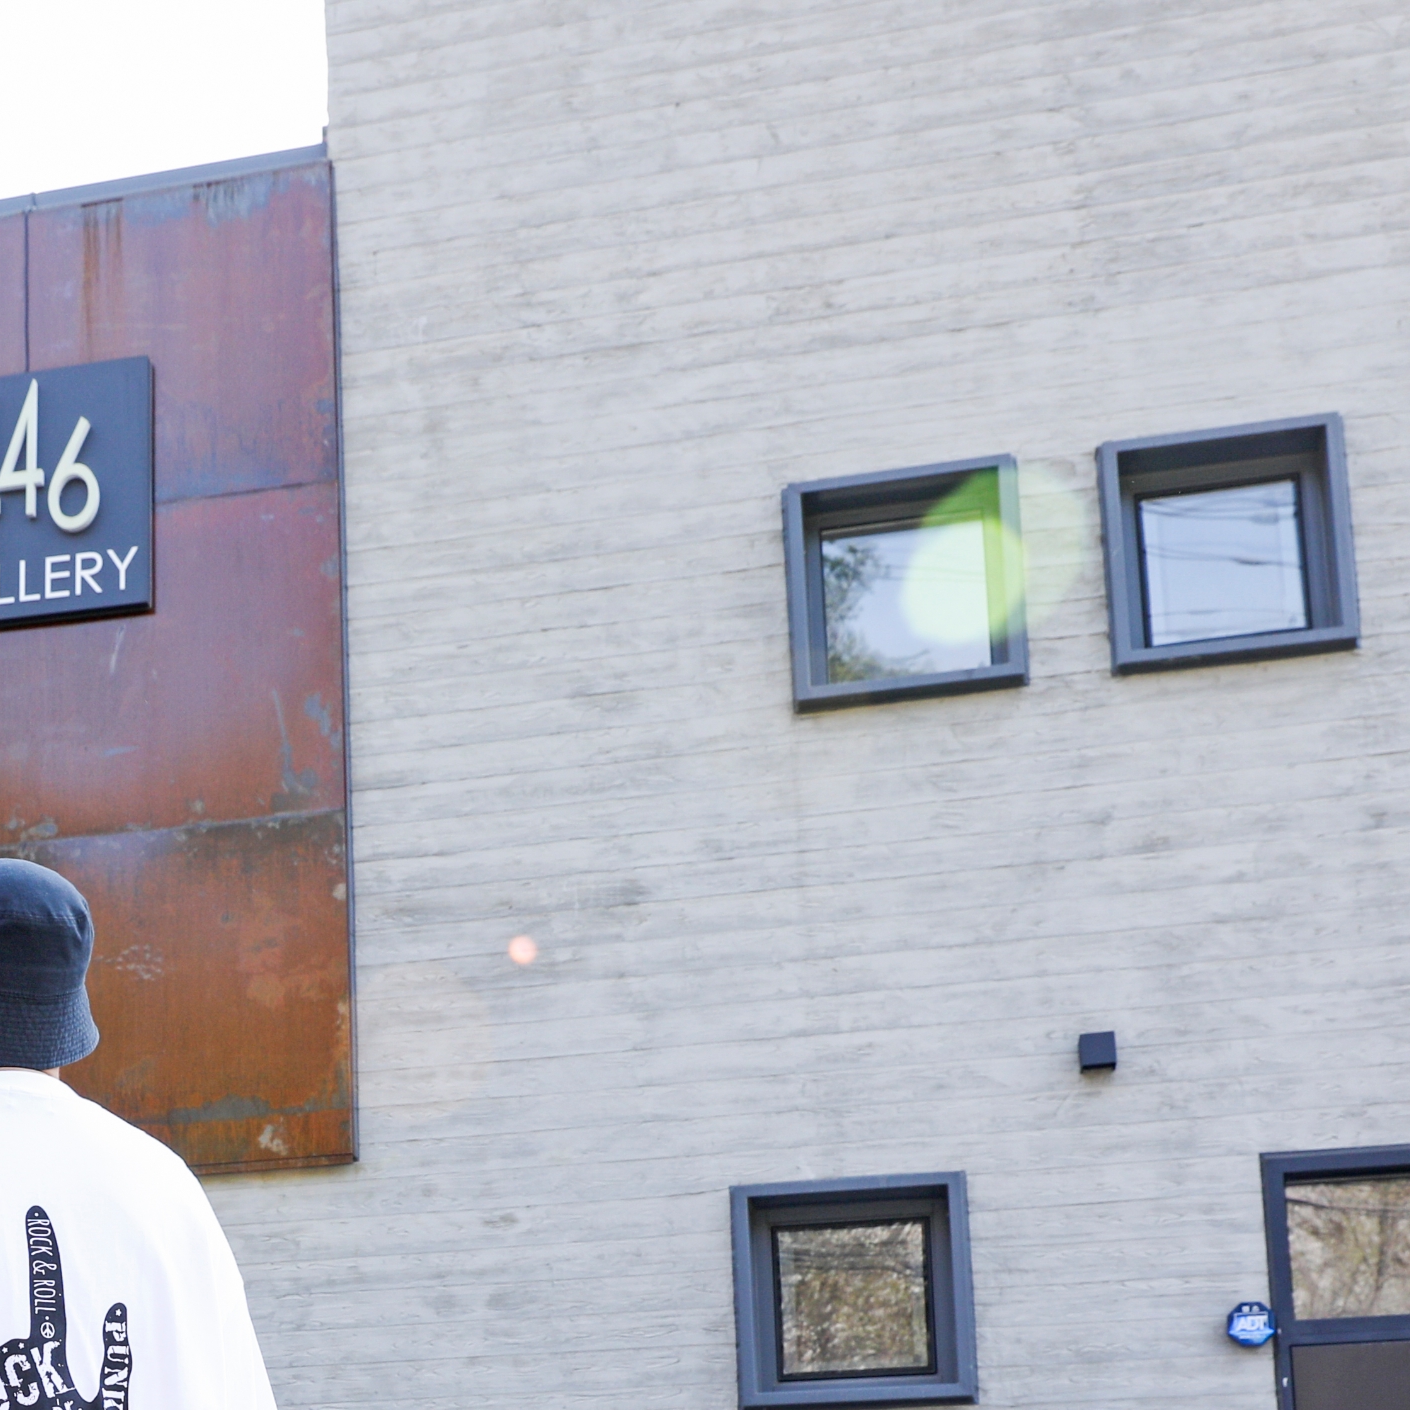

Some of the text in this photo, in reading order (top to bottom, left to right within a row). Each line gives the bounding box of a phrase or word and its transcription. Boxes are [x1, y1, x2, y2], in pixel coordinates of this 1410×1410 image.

[26, 1218, 58, 1315] ROCK & ROLL
[1236, 1315, 1268, 1331] ADT
